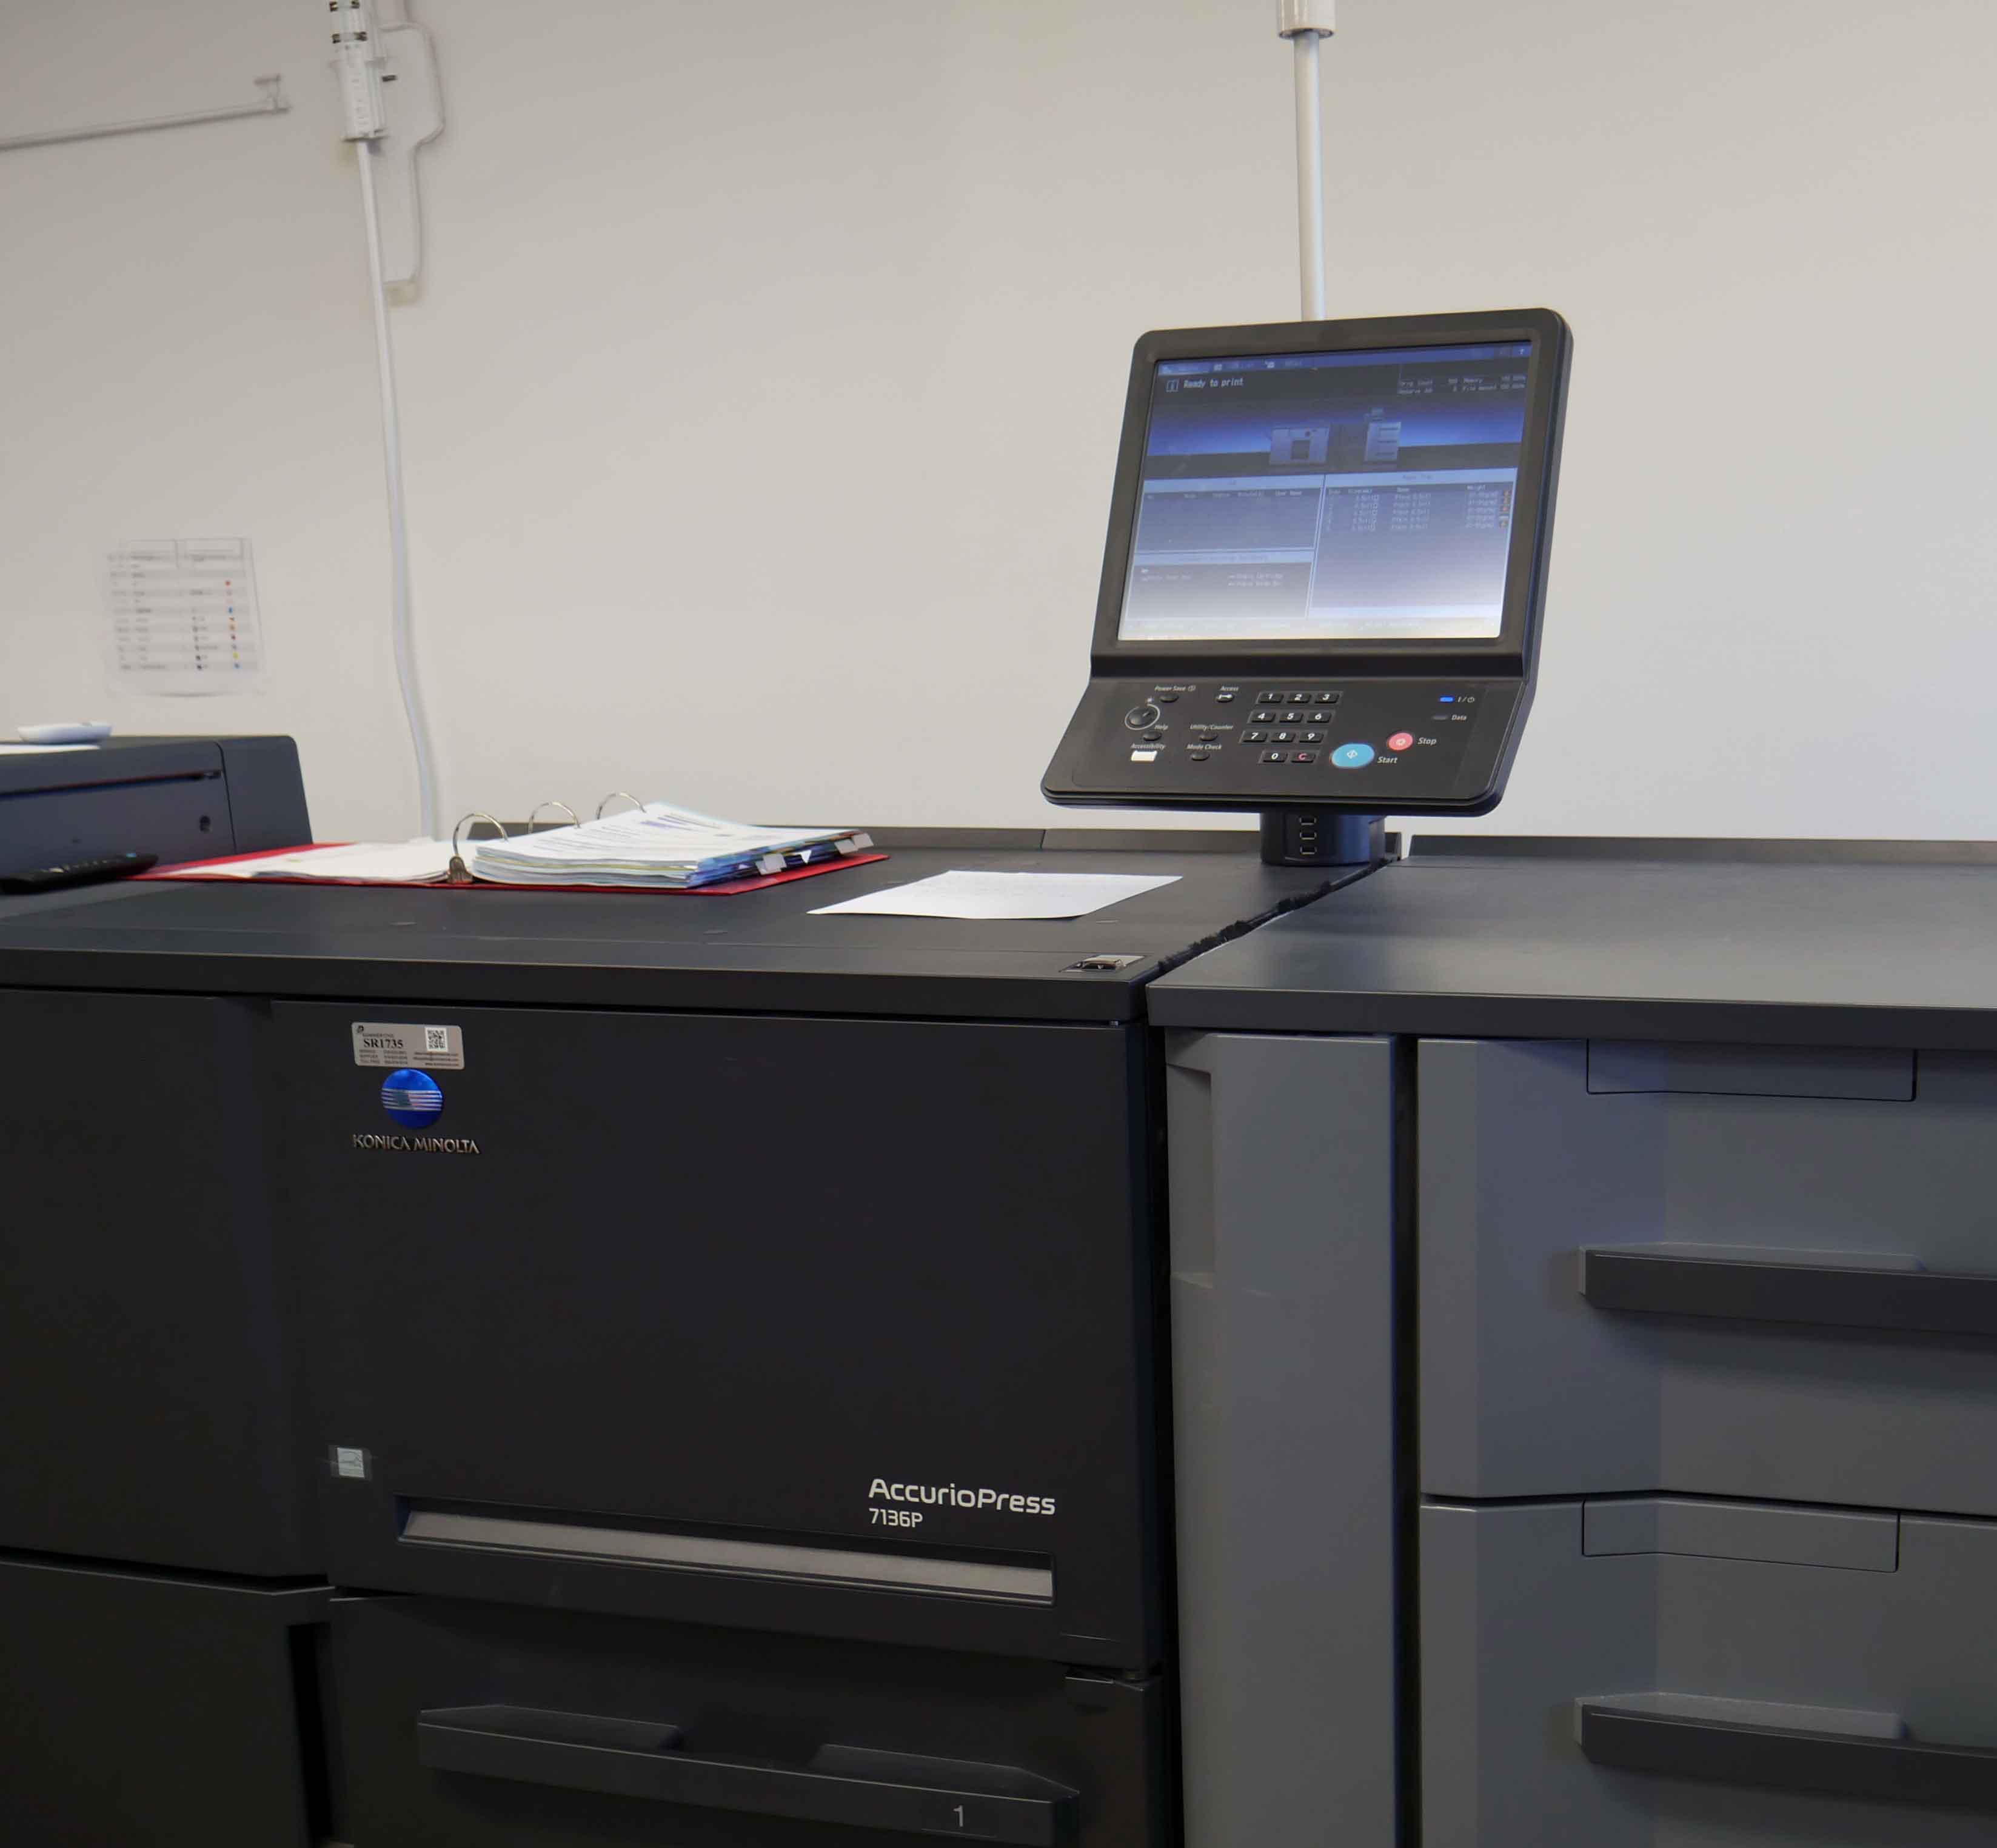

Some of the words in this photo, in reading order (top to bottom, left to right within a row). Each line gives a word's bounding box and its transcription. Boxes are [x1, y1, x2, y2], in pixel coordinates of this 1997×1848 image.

[1183, 379, 1206, 390] Ready
[1210, 379, 1218, 387] to
[1221, 378, 1243, 388] print
[1417, 737, 1437, 746] Stop
[363, 1038, 404, 1049] SR1735
[353, 1133, 411, 1151] KONICA
[413, 1136, 481, 1155] MINOLTA
[868, 1478, 1055, 1516] AccurioPress
[868, 1507, 923, 1529] 7136P
[952, 1804, 964, 1827] 1
